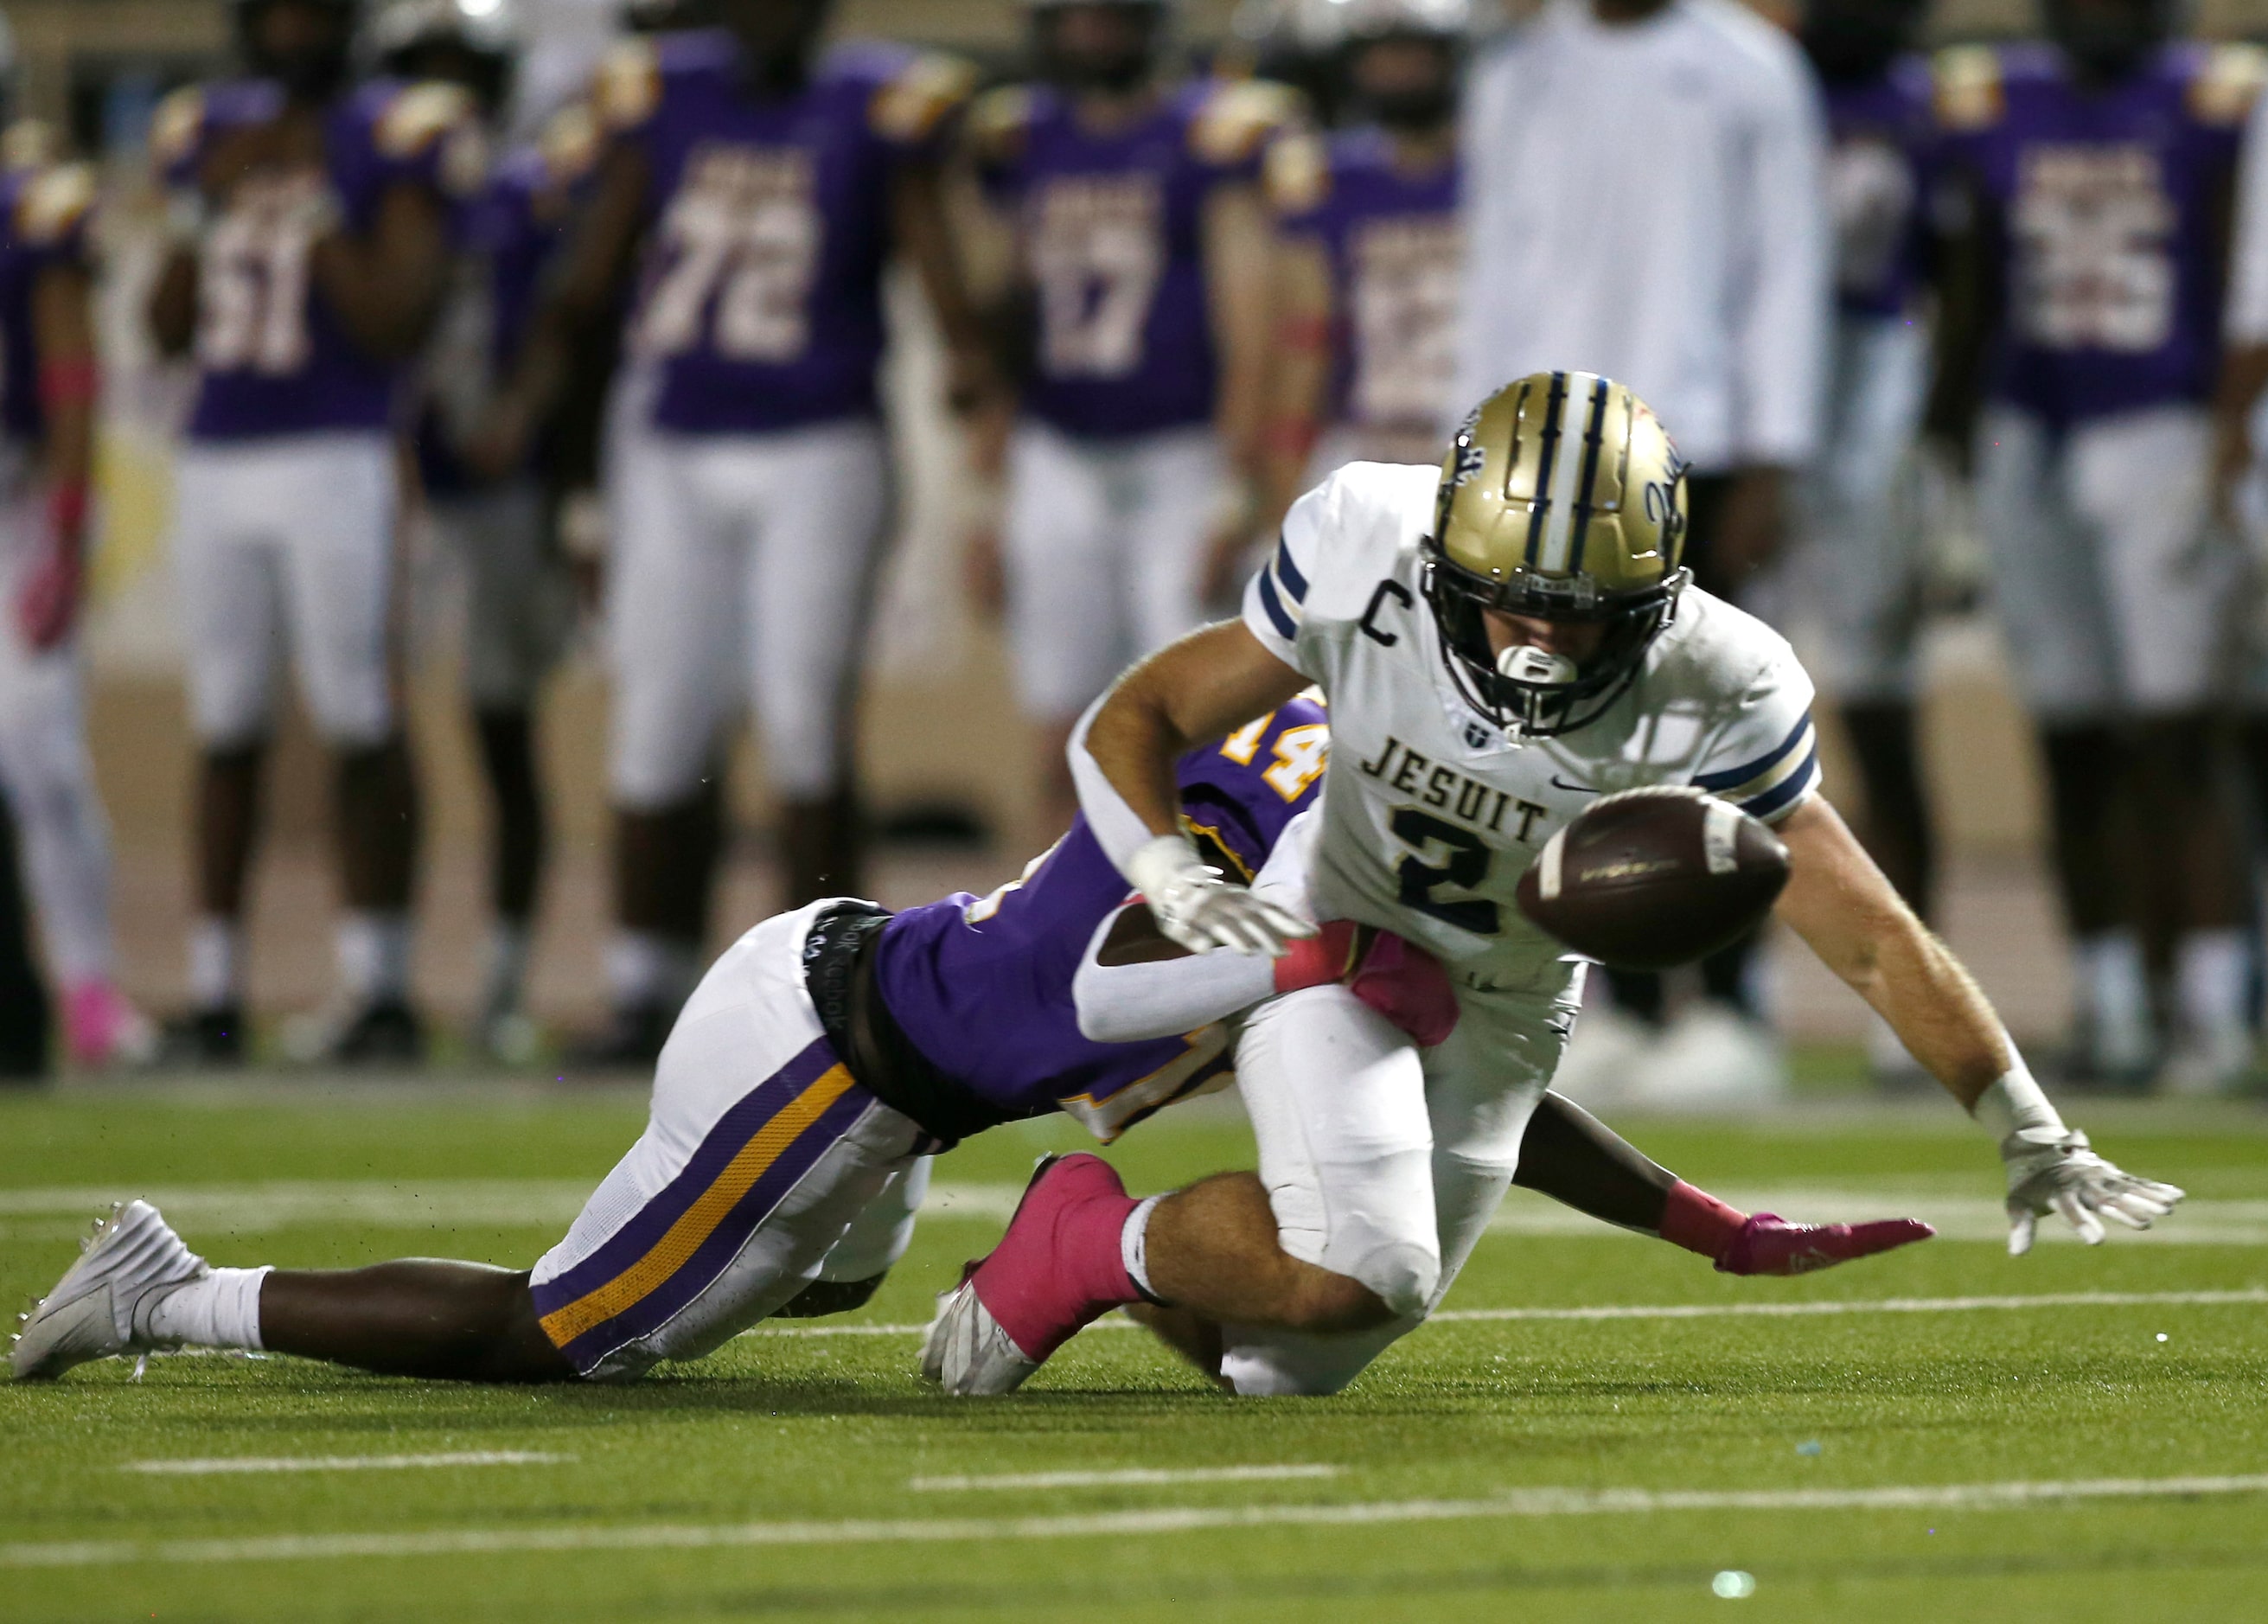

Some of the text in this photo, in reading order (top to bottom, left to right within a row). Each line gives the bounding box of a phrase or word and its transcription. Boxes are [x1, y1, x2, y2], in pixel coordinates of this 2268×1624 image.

[628, 192, 820, 361] 72
[1358, 579, 1415, 648] C
[1218, 709, 1330, 804] 14
[1361, 736, 1549, 843] JESUIT
[1387, 802, 1503, 937] 2
